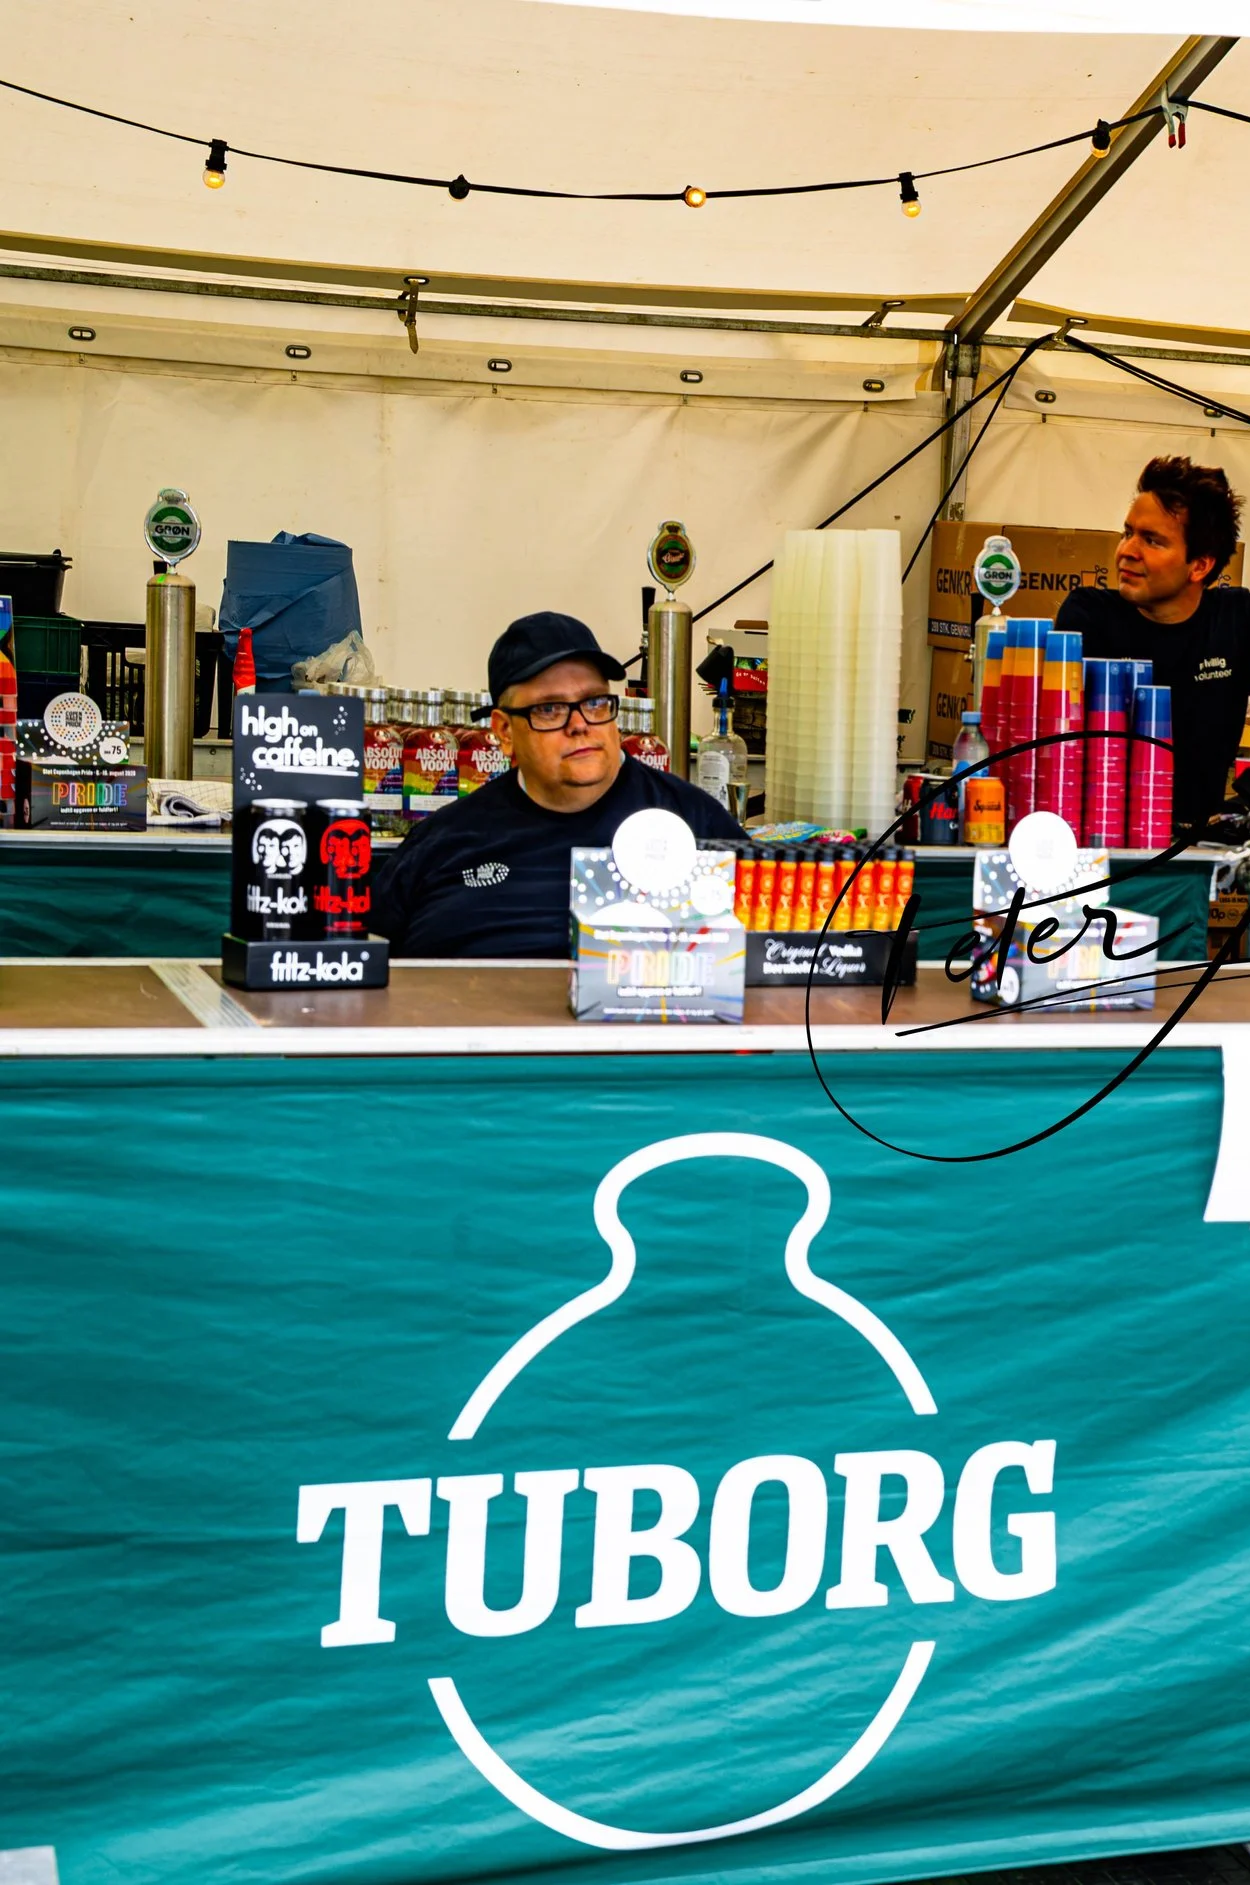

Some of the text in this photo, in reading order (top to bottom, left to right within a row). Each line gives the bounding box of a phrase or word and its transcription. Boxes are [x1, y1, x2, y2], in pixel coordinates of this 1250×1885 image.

[155, 525, 190, 536] GRØN
[983, 571, 1013, 580] GRØN
[242, 705, 318, 742] high on
[111, 745, 122, 755] 75
[252, 737, 360, 768] caffeine.
[415, 748, 458, 761] ABSOLUT
[365, 758, 400, 770] VODKA
[421, 760, 456, 772] VODKA
[53, 782, 128, 806] PRIDE
[270, 951, 363, 982] fritz-kola
[607, 950, 716, 986] PRIDE
[295, 1438, 1058, 1649] TUBORG
